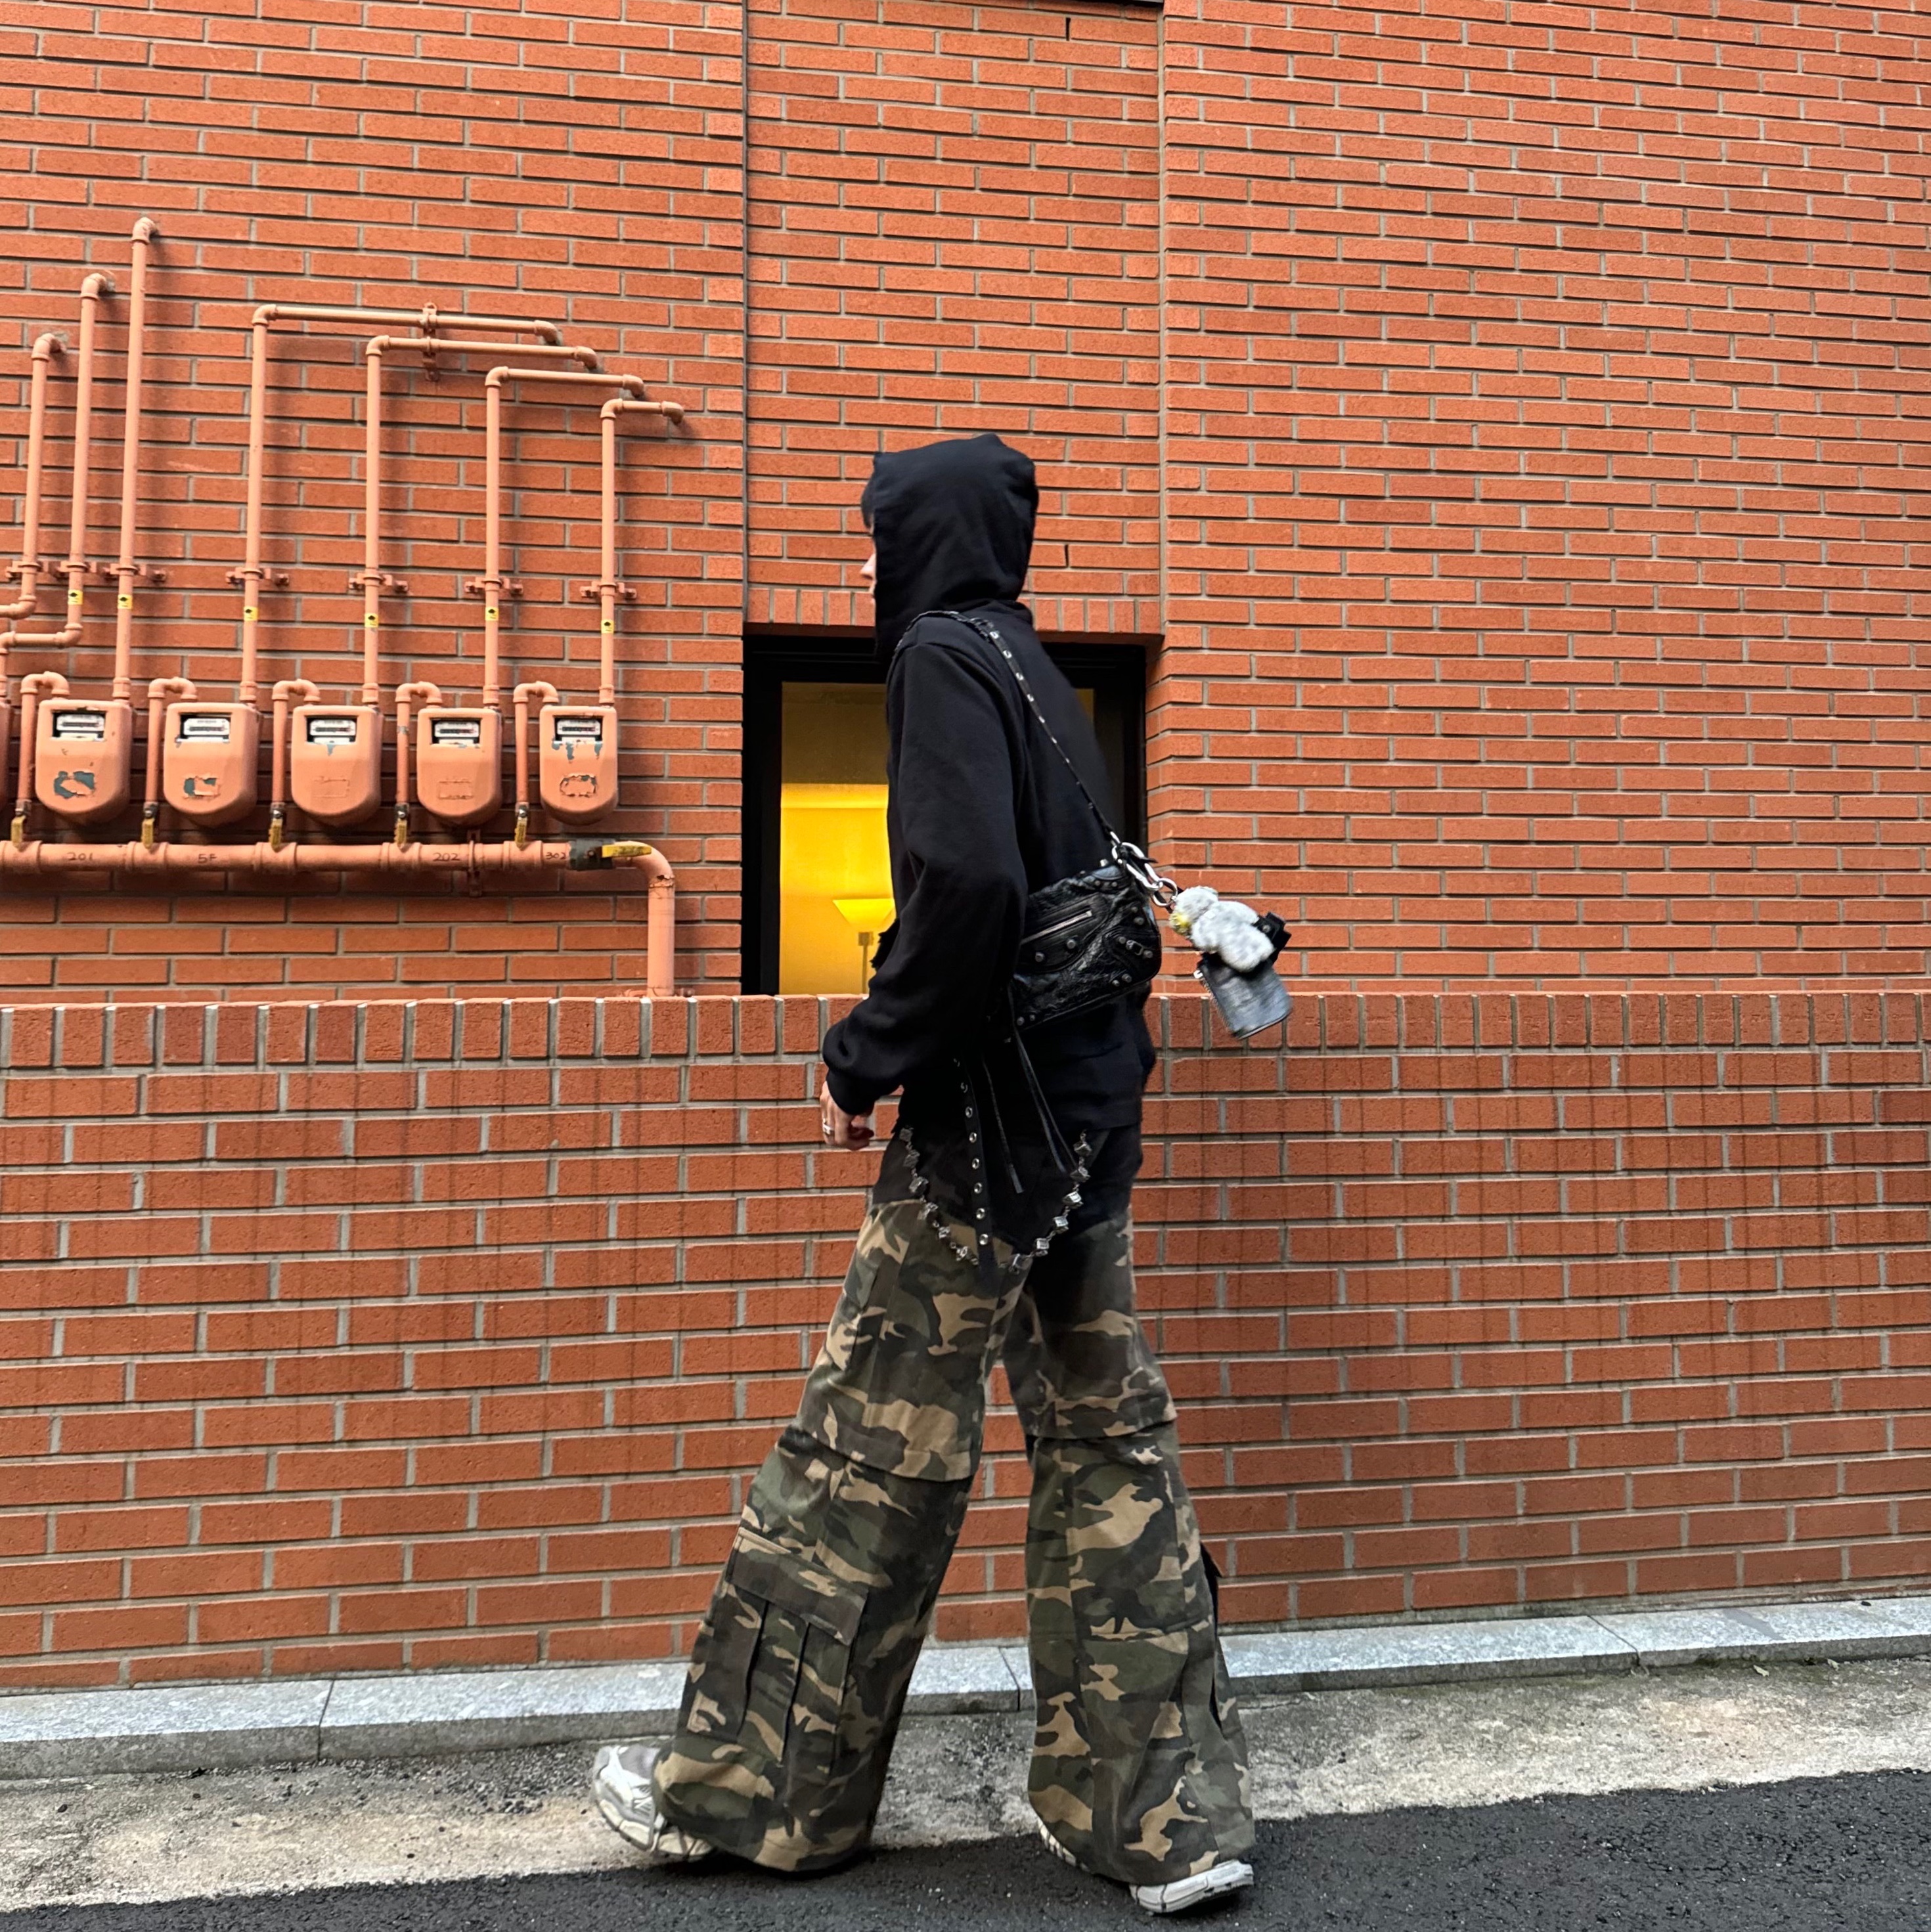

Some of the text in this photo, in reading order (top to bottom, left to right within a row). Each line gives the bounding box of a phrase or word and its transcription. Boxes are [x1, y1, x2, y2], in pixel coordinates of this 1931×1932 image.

[67, 852, 93, 861] 201
[198, 853, 217, 864] 5F
[433, 852, 460, 862] 202
